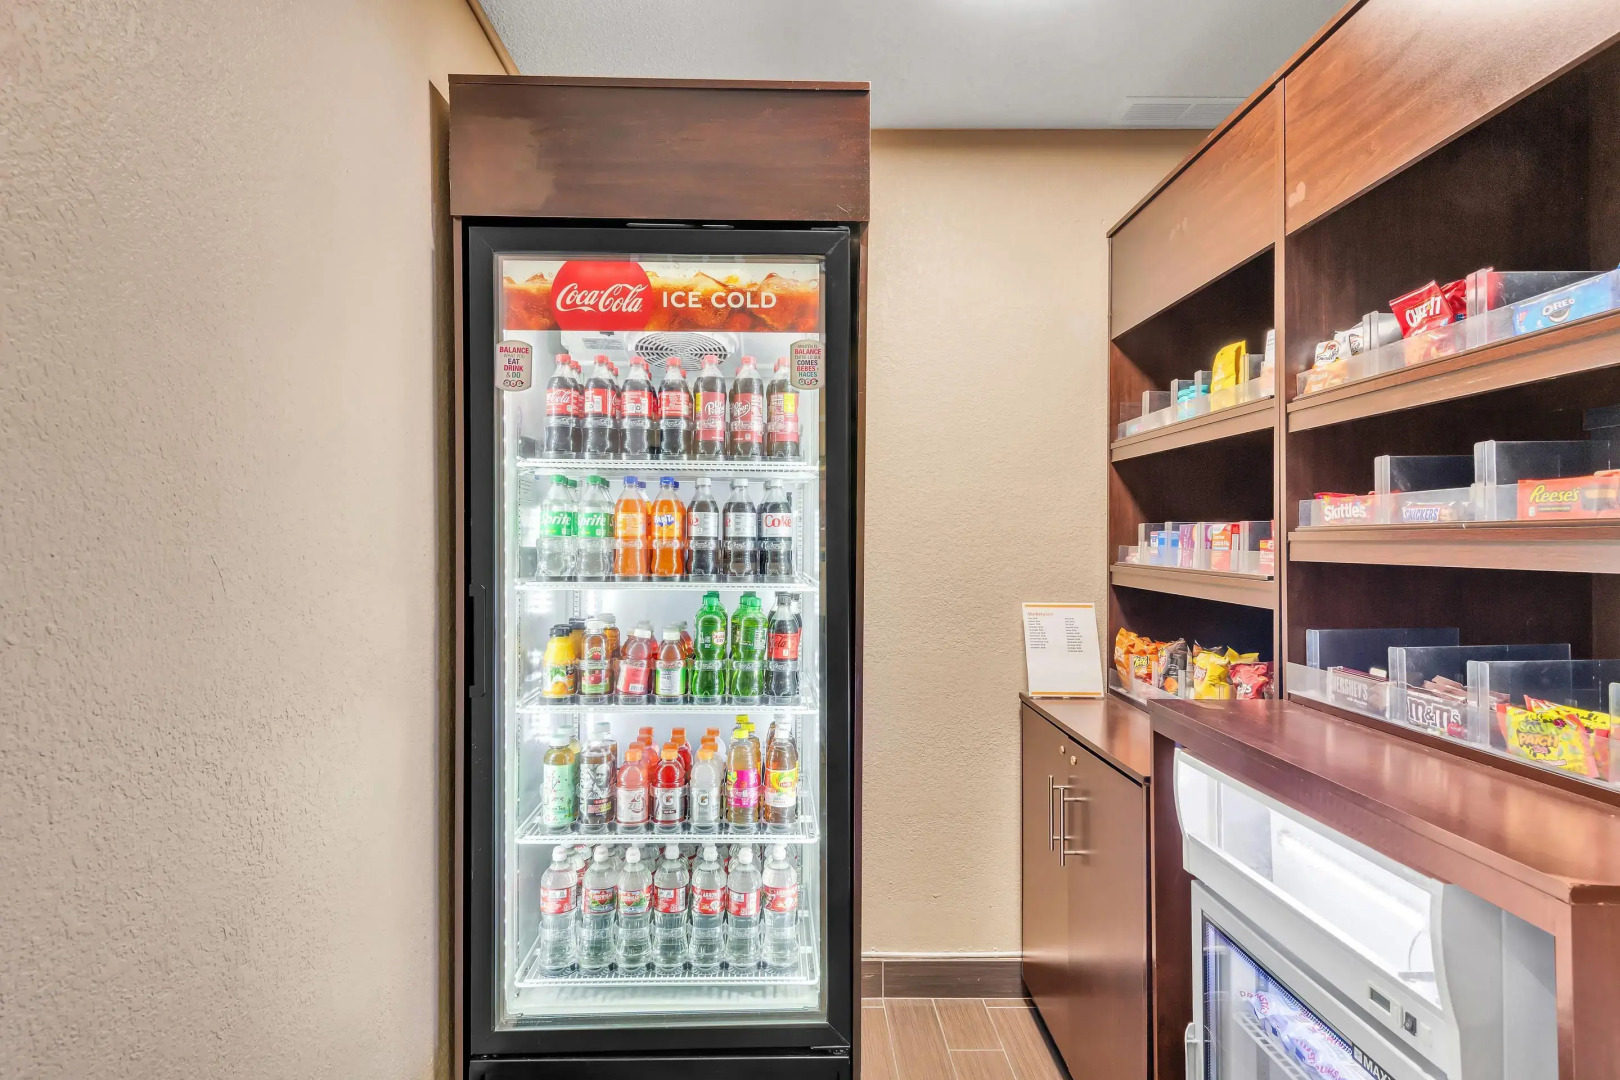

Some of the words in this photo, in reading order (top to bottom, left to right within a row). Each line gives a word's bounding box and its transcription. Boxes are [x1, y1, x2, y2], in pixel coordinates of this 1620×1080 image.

[556, 283, 648, 312] Coca-Cola
[662, 291, 702, 308] ICE
[711, 291, 777, 309] COLD
[1542, 298, 1576, 316] OREO
[499, 346, 530, 355] BALANCE
[1529, 484, 1579, 503] Reese's
[764, 513, 792, 527] Coke
[1323, 502, 1367, 521] Skittles
[1403, 508, 1439, 521] SNICKERS
[1518, 733, 1559, 748] PATCH
